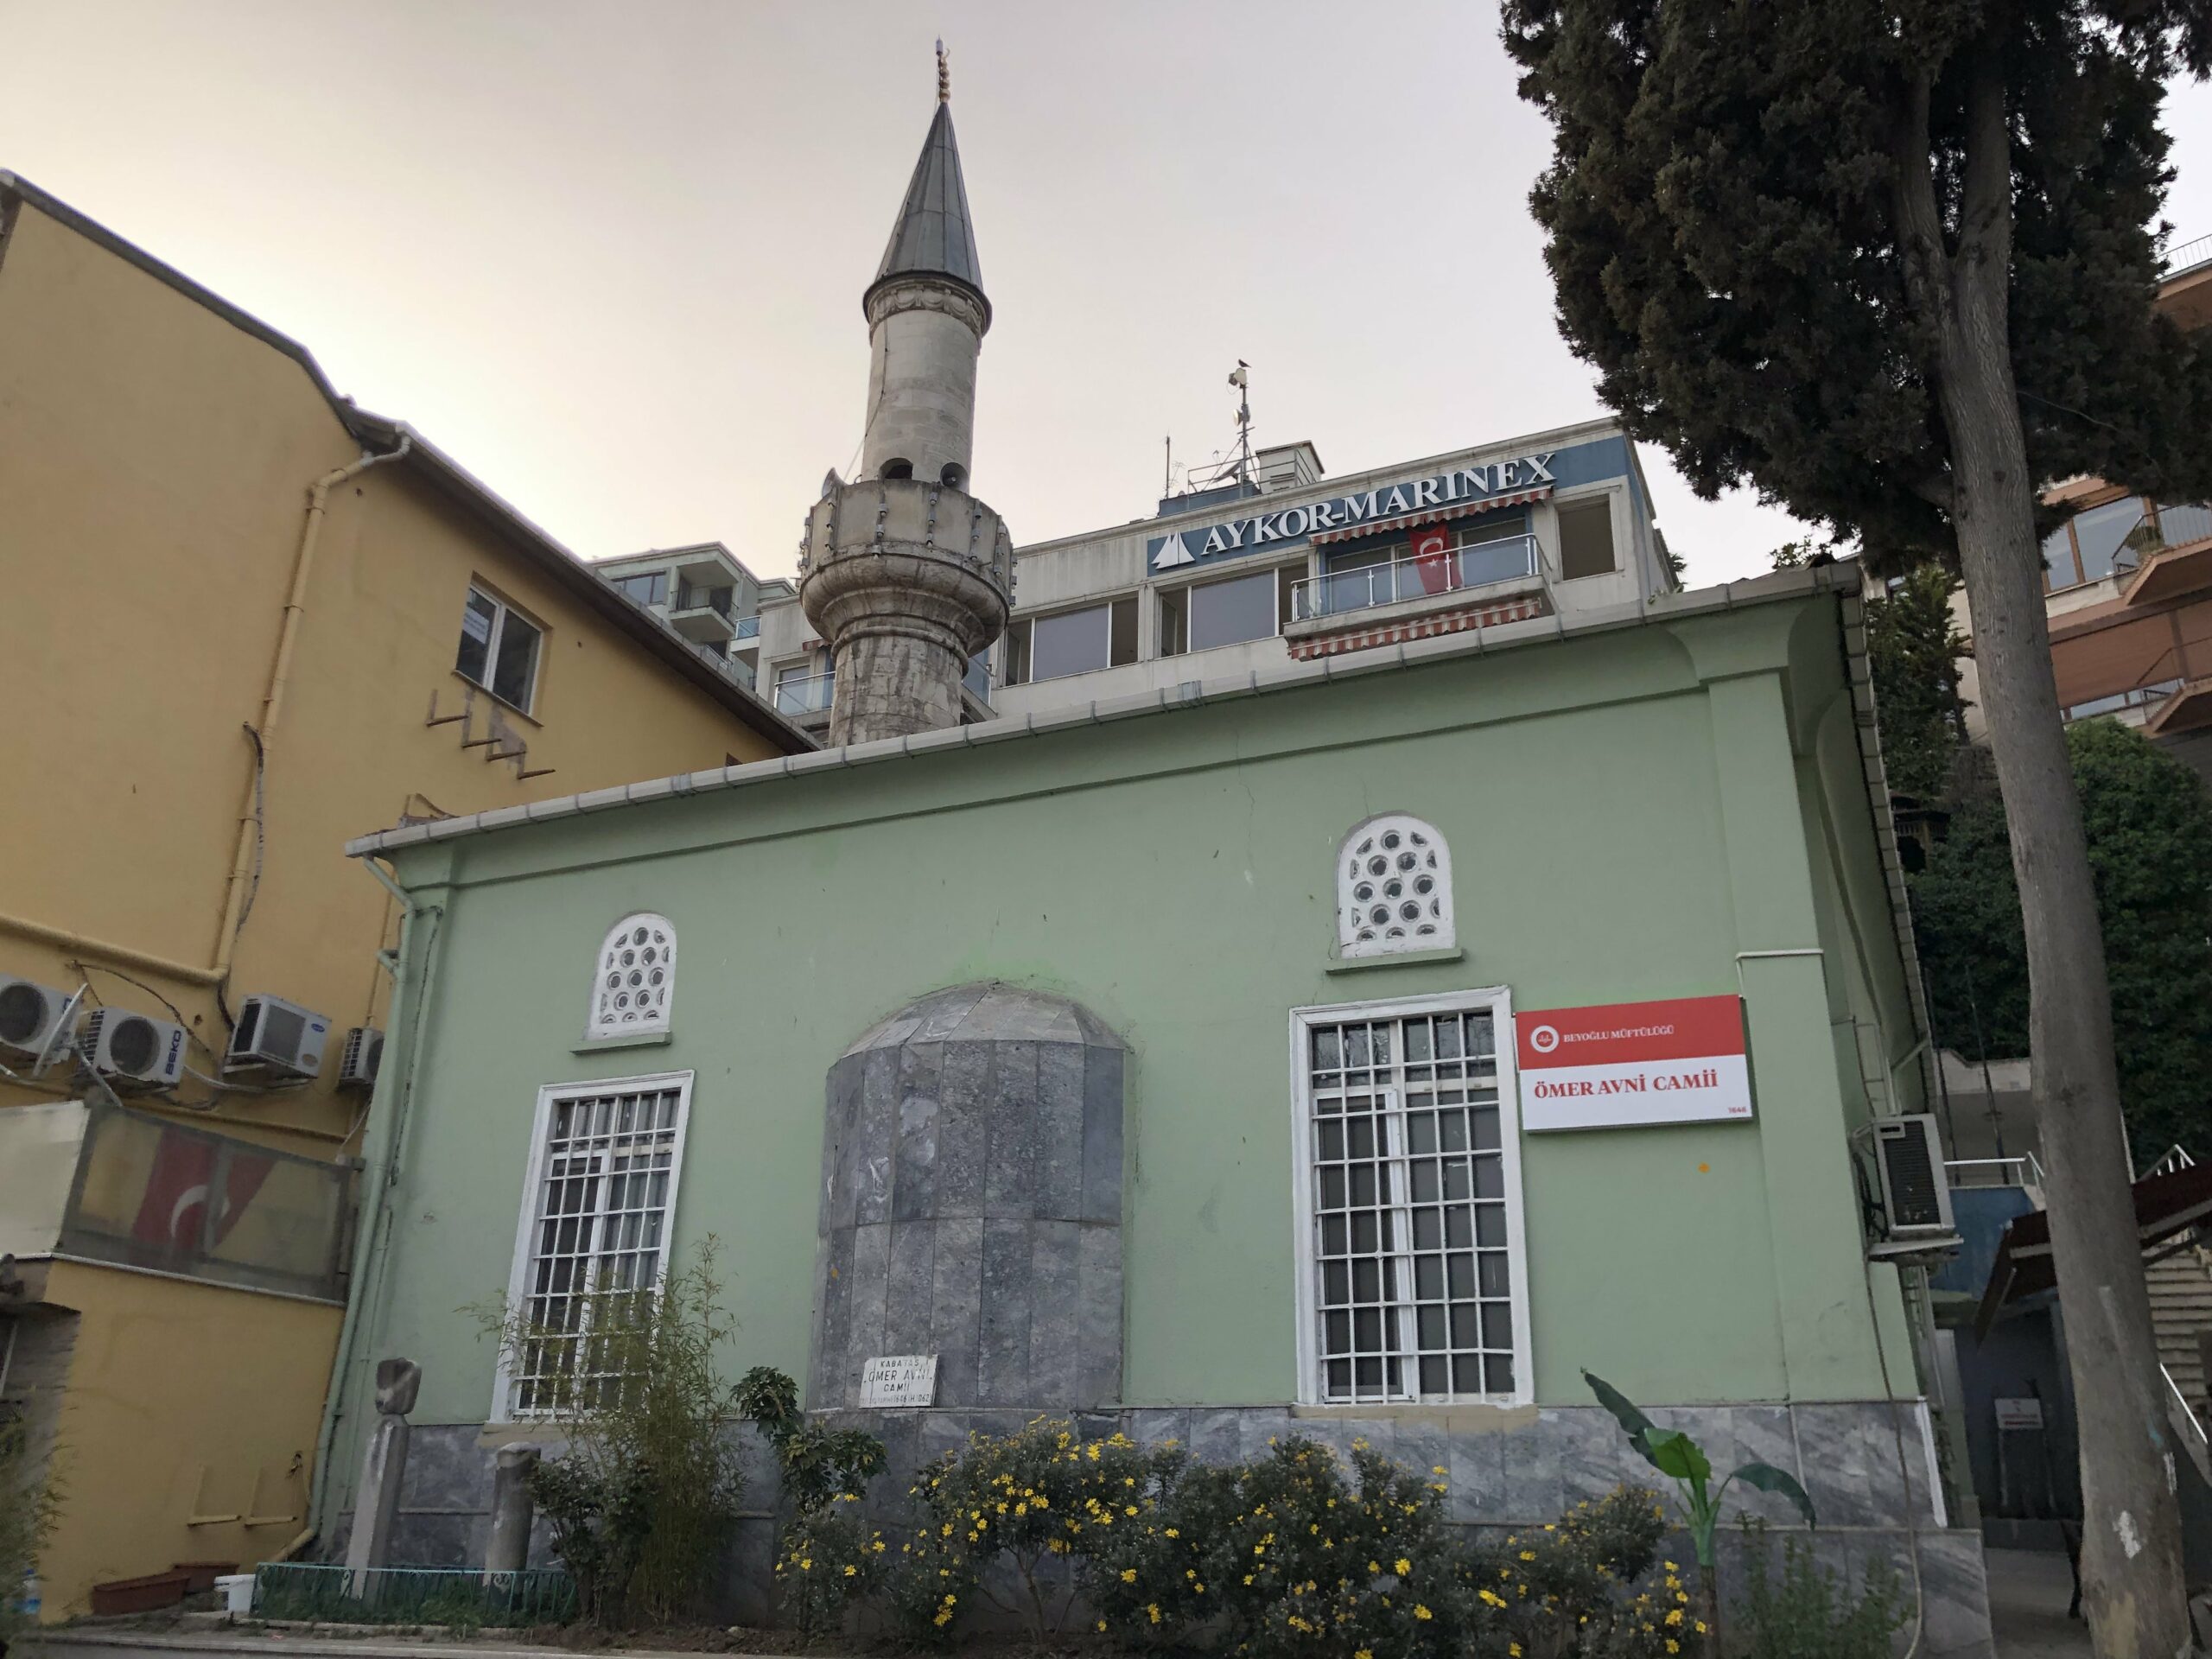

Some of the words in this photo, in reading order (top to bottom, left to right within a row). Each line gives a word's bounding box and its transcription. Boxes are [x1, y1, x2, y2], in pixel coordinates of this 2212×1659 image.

[1201, 453, 1556, 556] AYKOR-MARINEX
[1563, 1029, 1609, 1043] BEYOĞLU
[1611, 1024, 1675, 1039] MÜFTÜLÜĞÜ
[165, 1030, 181, 1075] BEKO
[1534, 1081, 1594, 1098] ÖMER
[1599, 1074, 1646, 1094] AVNİ
[1653, 1069, 1719, 1091] CAMİİ
